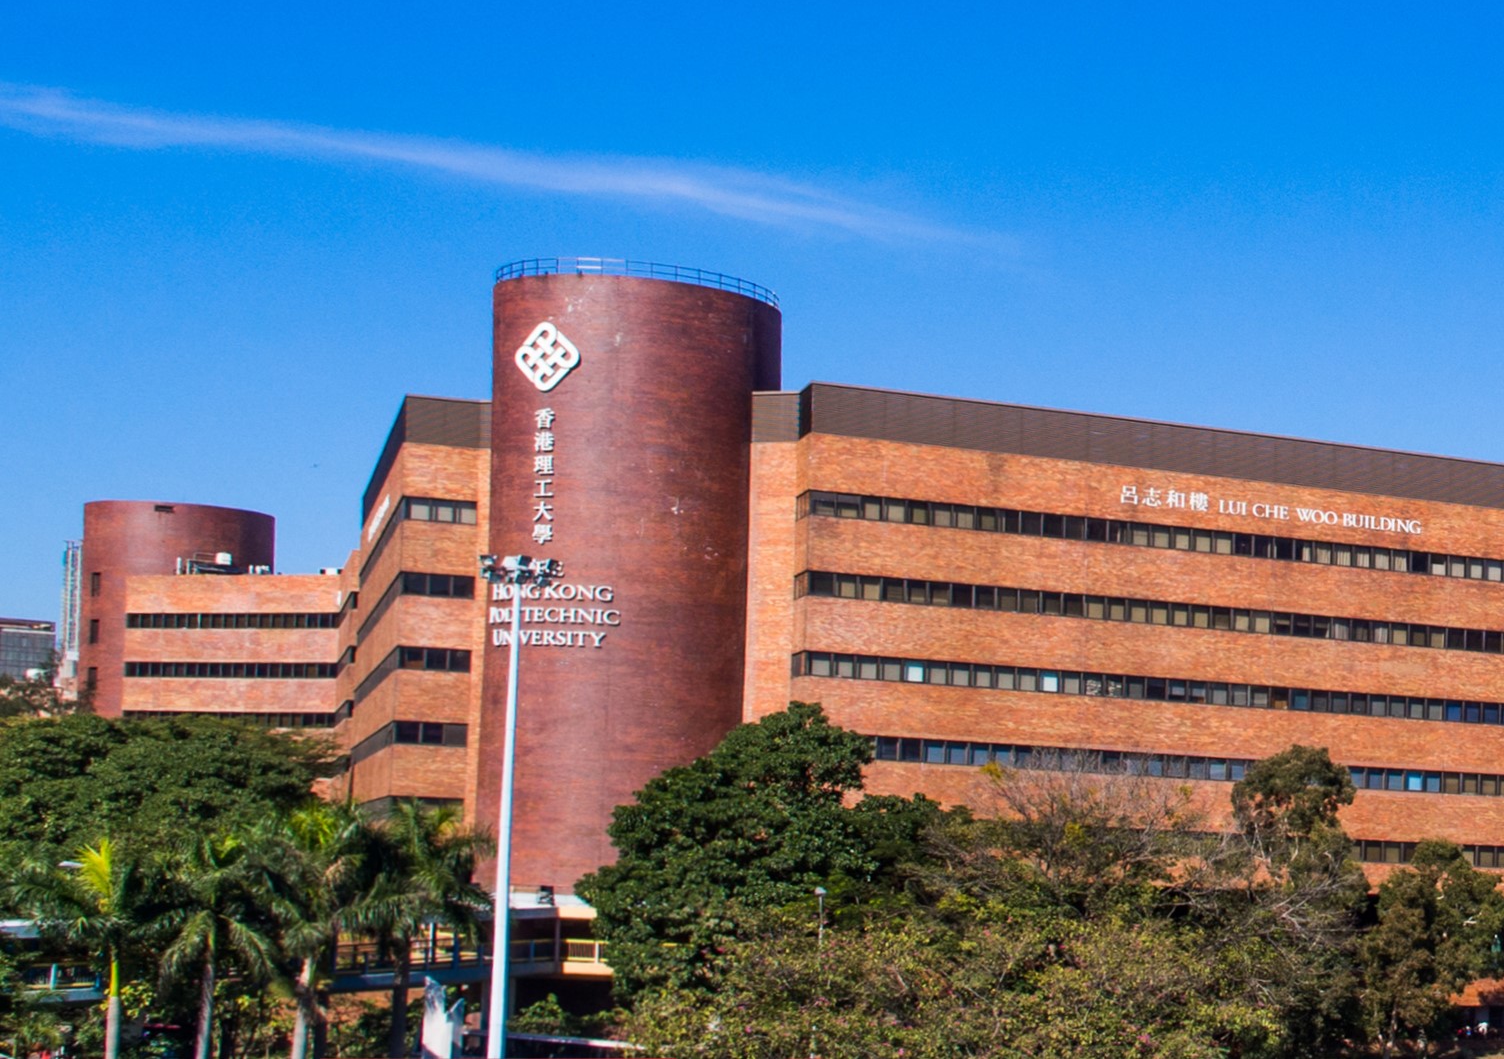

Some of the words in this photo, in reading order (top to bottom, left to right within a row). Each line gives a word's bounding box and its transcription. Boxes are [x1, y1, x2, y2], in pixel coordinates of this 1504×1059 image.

[532, 407, 556, 545] 香港理工大學
[1120, 485, 1209, 512] 呂志和樓
[1218, 499, 1247, 516] LUI
[1252, 503, 1290, 520] CHE
[1296, 507, 1338, 525] WOO
[1343, 513, 1422, 534] BUILDING
[543, 581, 615, 602] KONG
[489, 606, 621, 626] POLTECHNIC
[492, 628, 607, 648] UNVERSITY
